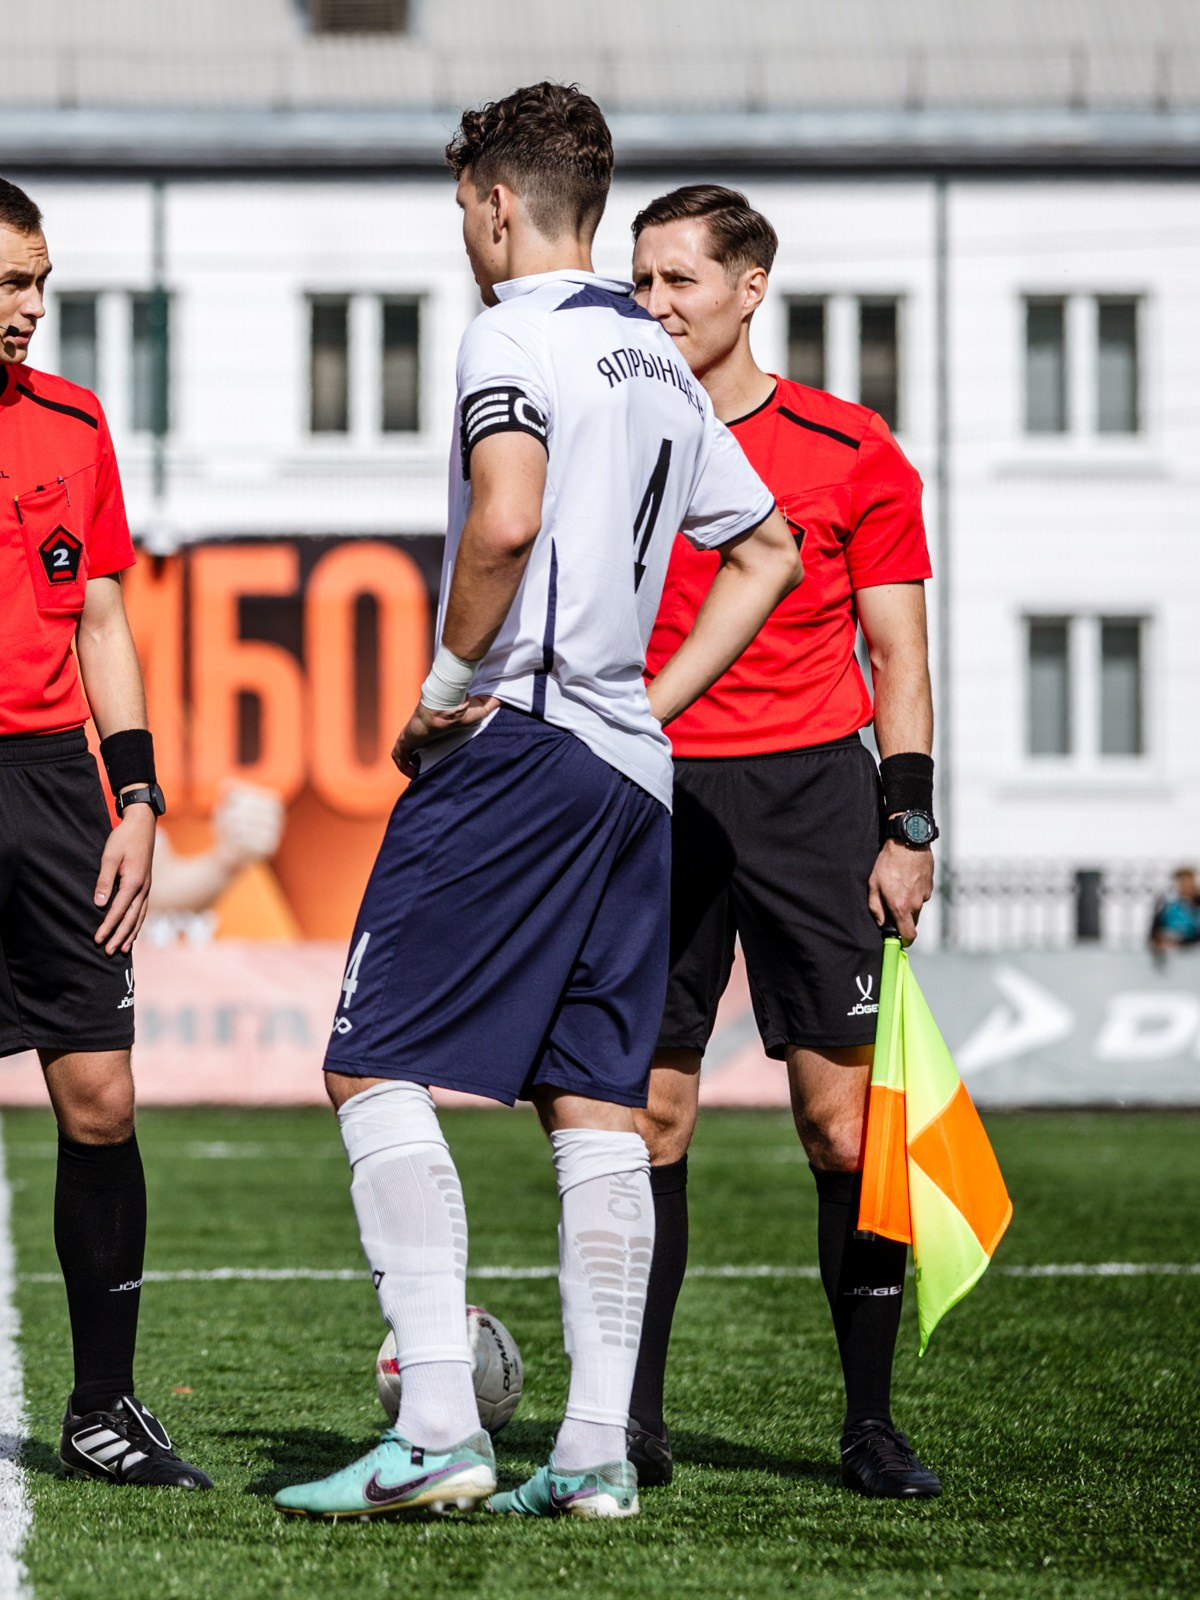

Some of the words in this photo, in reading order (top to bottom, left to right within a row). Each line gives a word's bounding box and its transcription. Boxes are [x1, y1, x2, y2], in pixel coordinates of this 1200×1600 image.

[633, 438, 673, 594] 4
[53, 548, 70, 567] 2
[342, 931, 370, 1009] 4
[1095, 991, 1200, 1062] D
